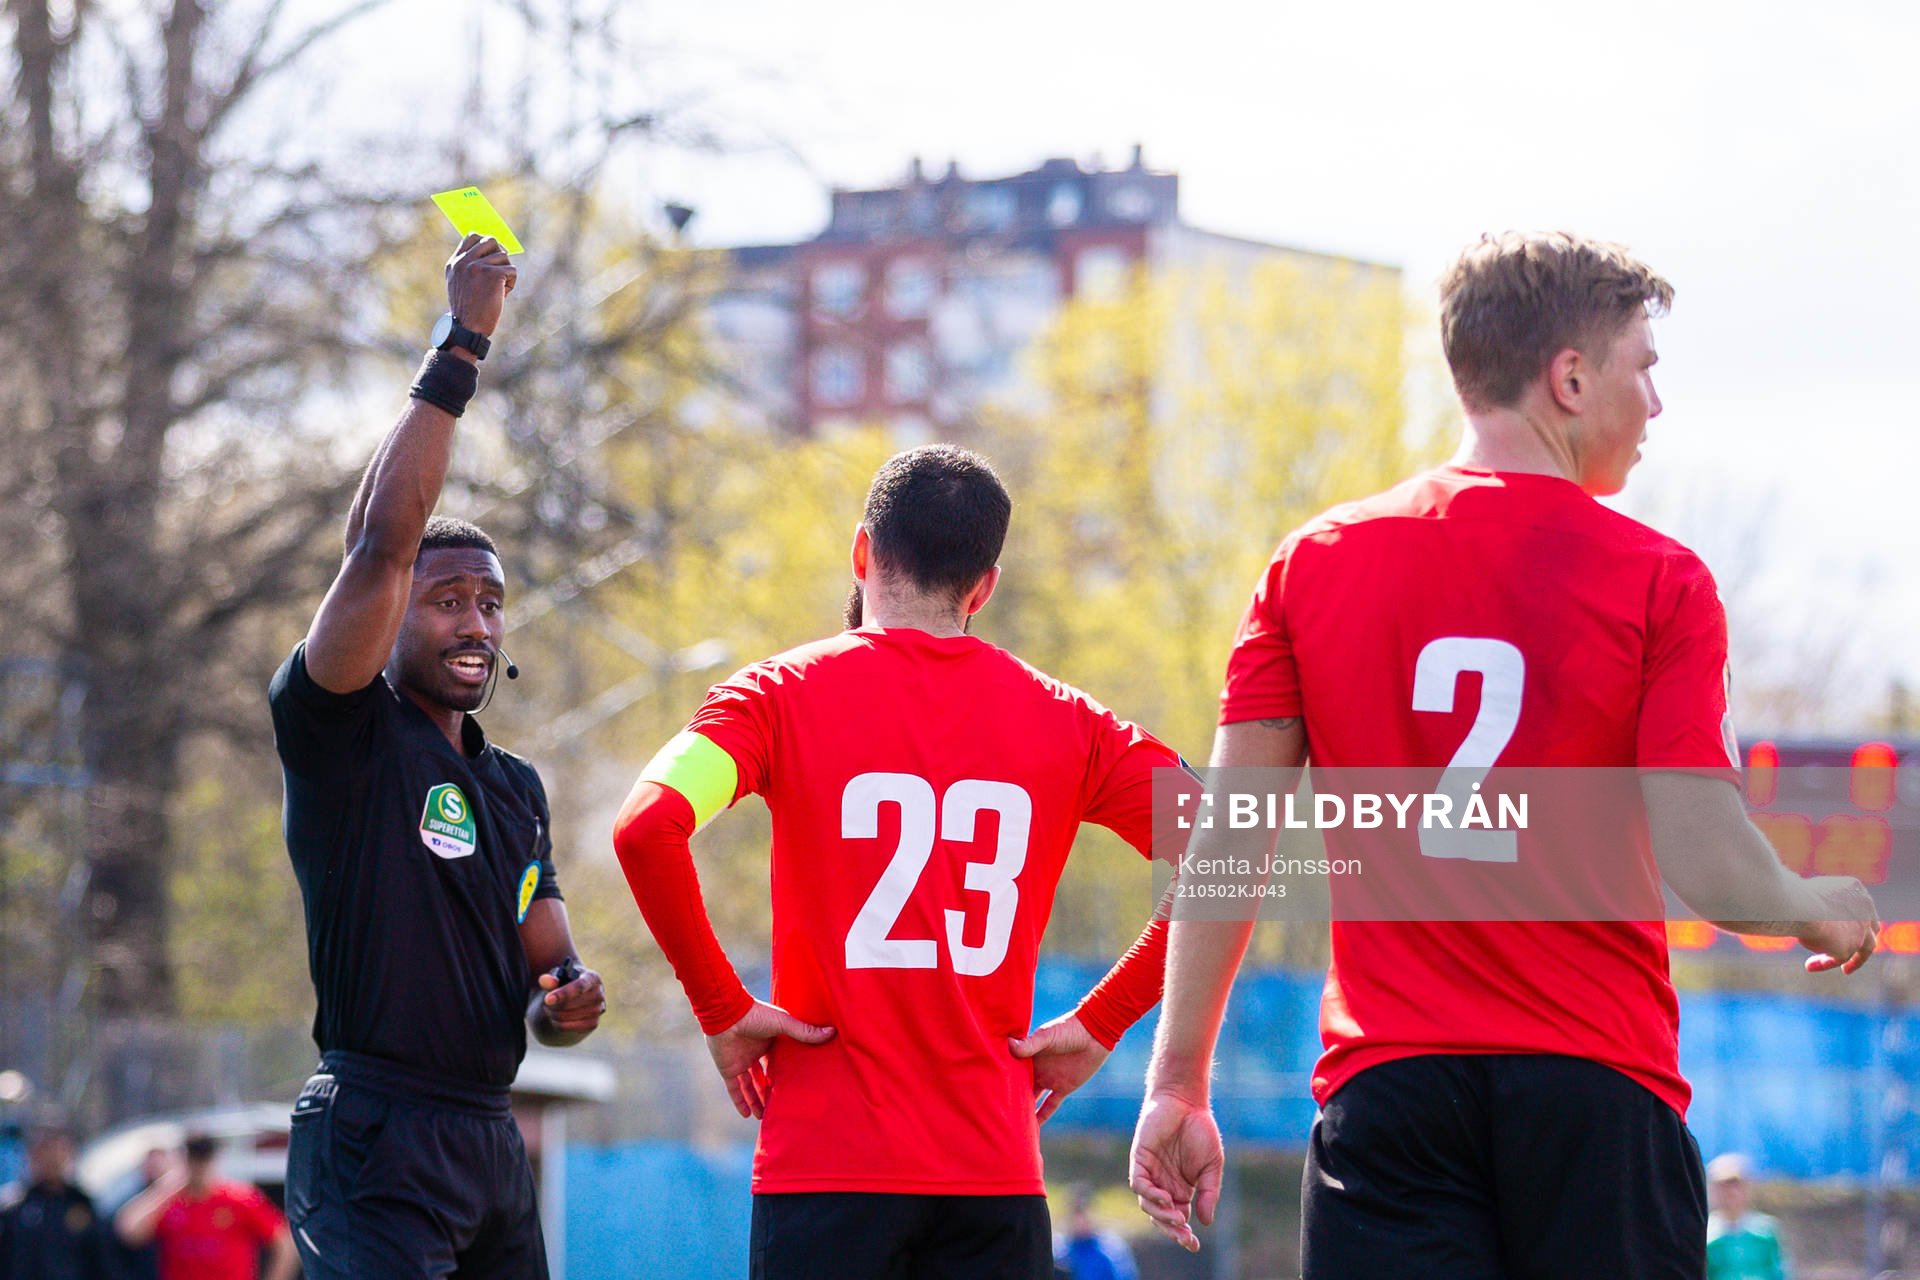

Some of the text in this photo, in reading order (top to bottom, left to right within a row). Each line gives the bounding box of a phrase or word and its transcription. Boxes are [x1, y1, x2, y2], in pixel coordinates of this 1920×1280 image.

[429, 819, 469, 840] SUPERETTAN
[1412, 637, 1525, 862] 2
[841, 772, 1032, 977] 23
